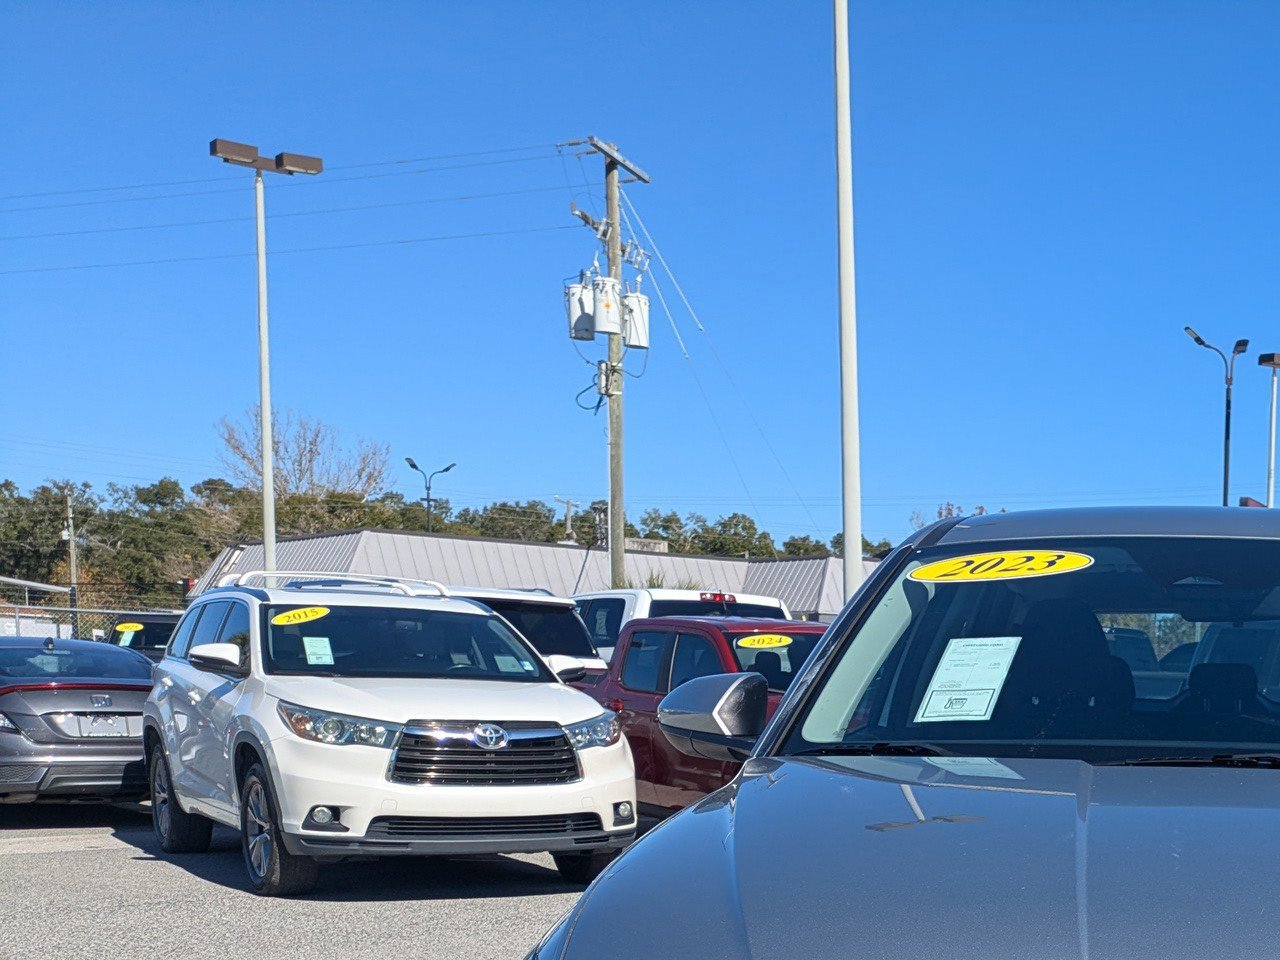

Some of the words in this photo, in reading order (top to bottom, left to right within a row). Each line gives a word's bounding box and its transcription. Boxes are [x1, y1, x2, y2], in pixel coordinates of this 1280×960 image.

[935, 554, 1066, 579] 2023
[283, 608, 319, 624] 2015
[749, 636, 783, 646] 2024
